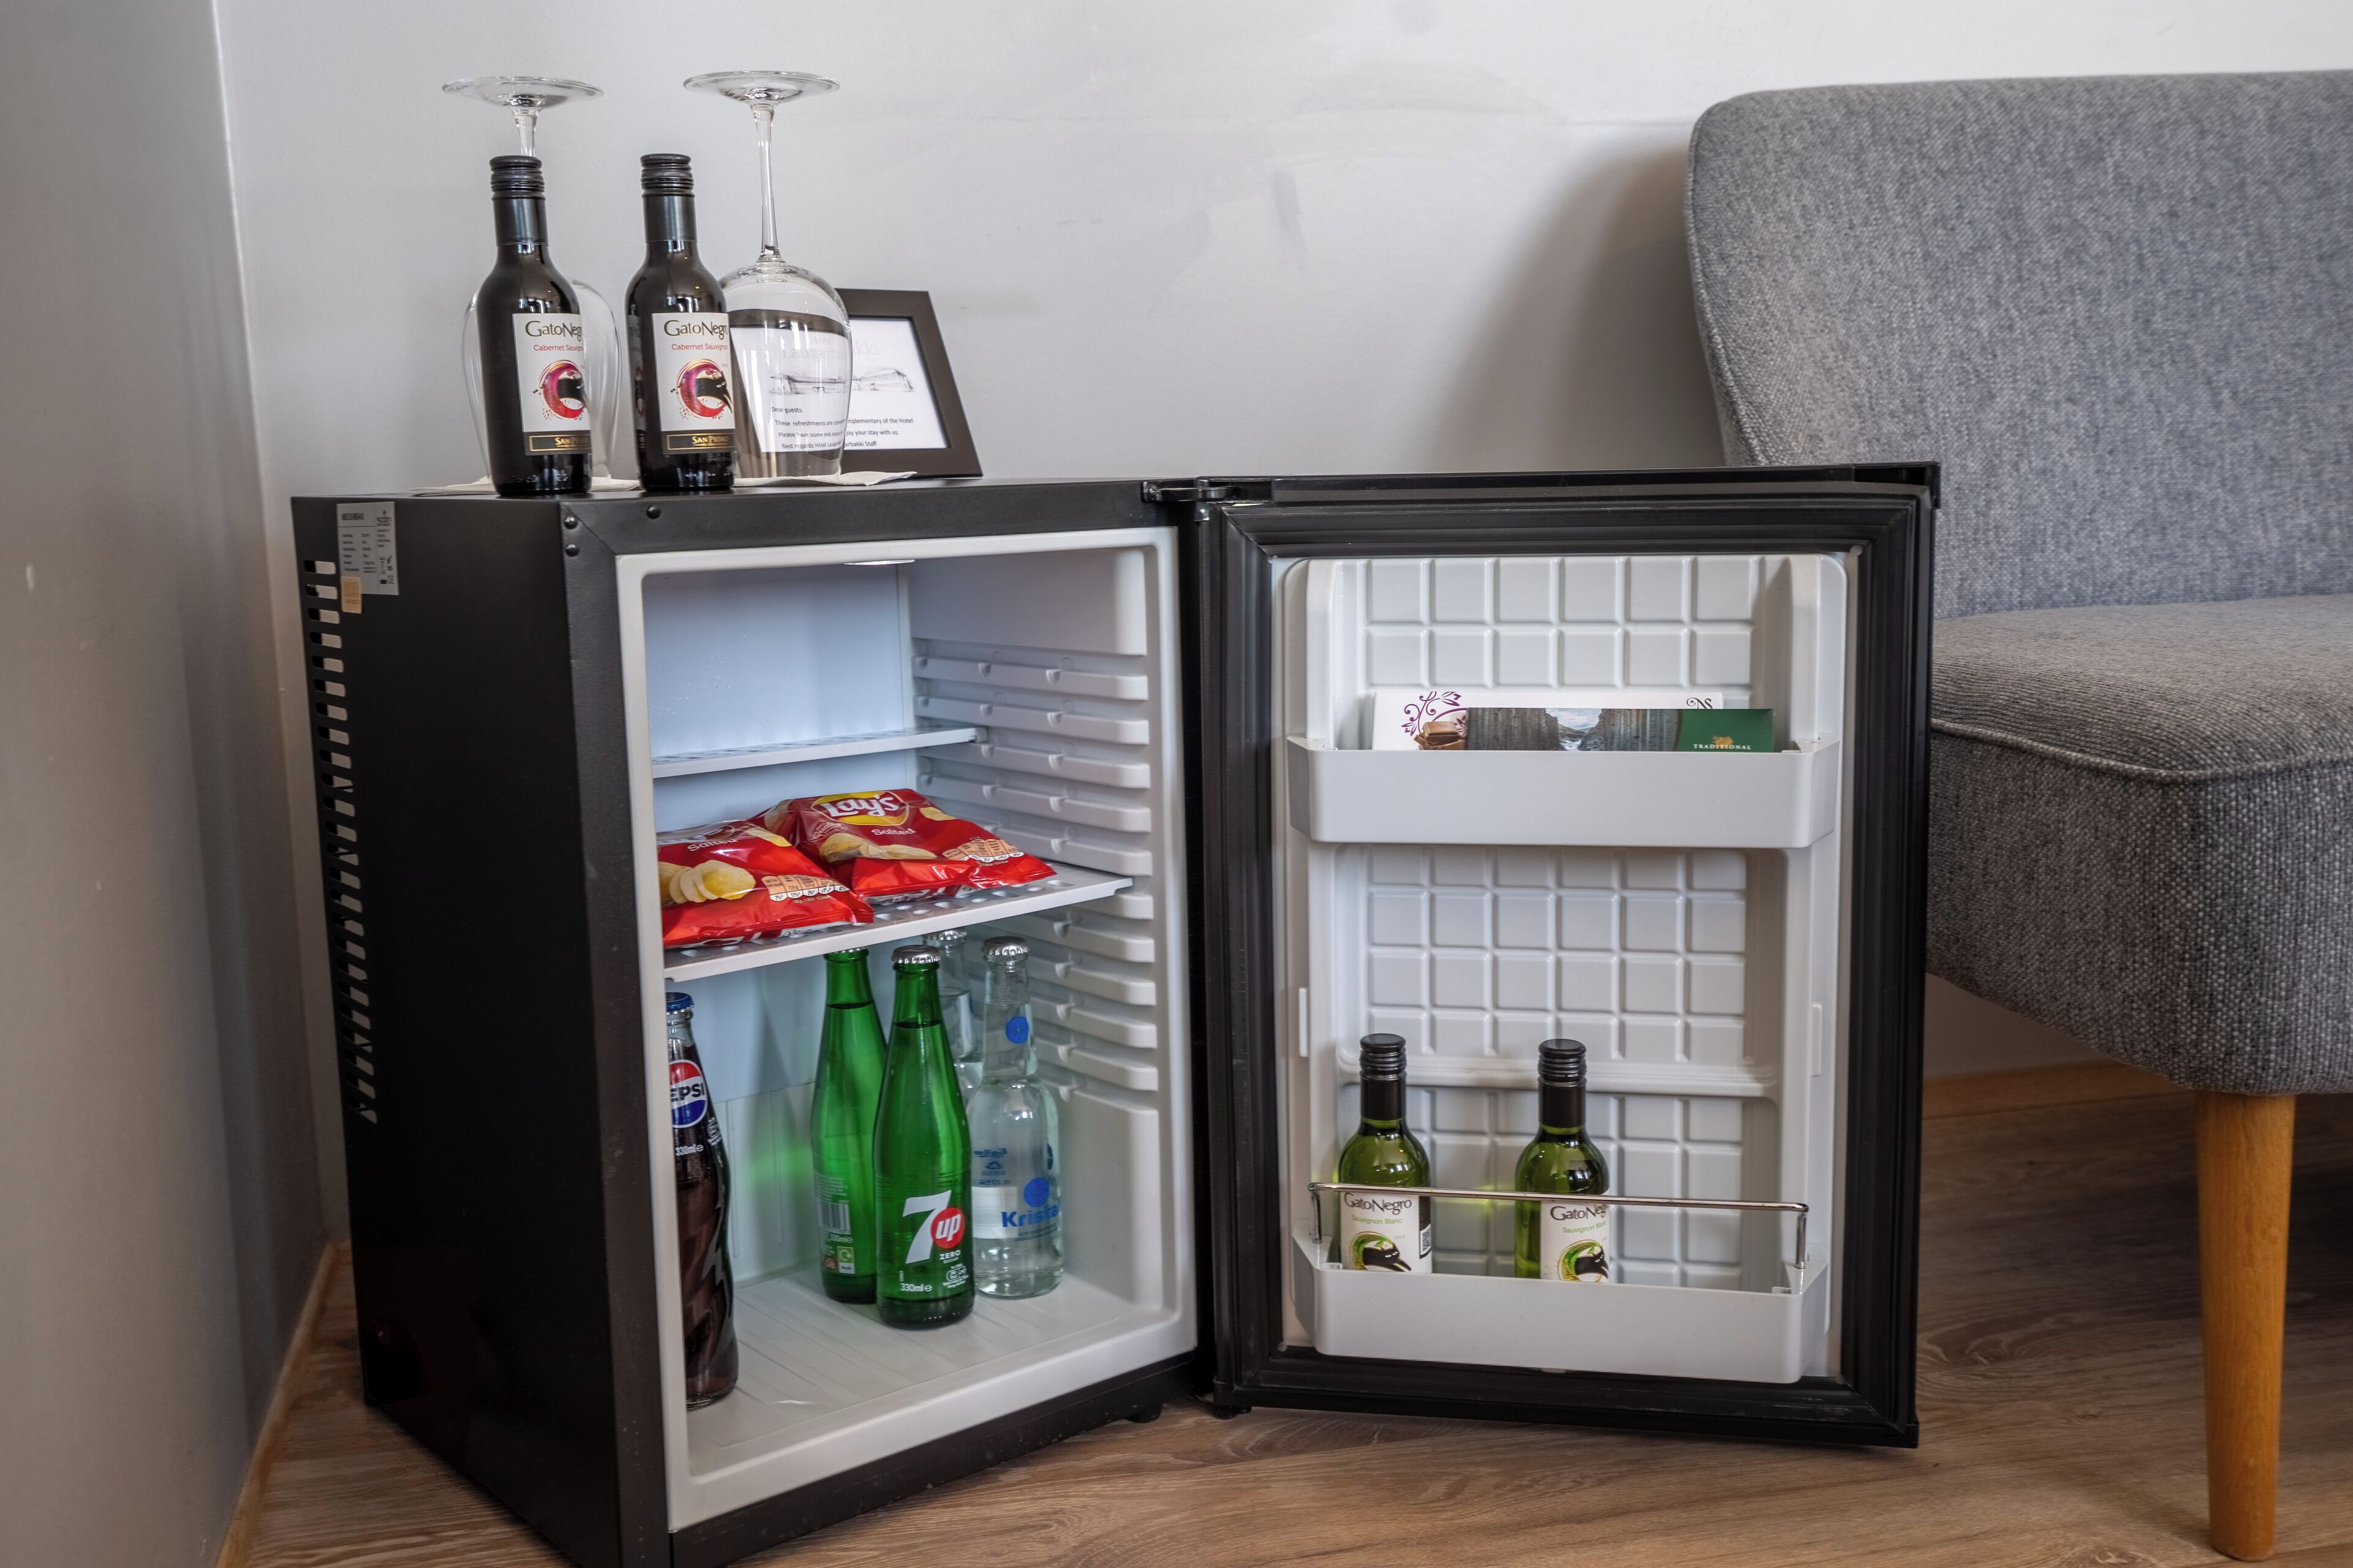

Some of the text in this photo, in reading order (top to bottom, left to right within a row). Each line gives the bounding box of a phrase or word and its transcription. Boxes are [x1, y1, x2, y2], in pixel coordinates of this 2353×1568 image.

[525, 320, 583, 341] GatoNeg
[821, 794, 900, 817] Lay's
[670, 1082, 705, 1102] EPSI
[1343, 1192, 1412, 1215] GatoNegro
[1550, 1205, 1608, 1221] GatoNeg
[1001, 1202, 1060, 1227] Krista
[1562, 1225, 1595, 1234] Sauvignon
[939, 1250, 961, 1260] ZERO
[901, 1283, 924, 1292] 330ml
